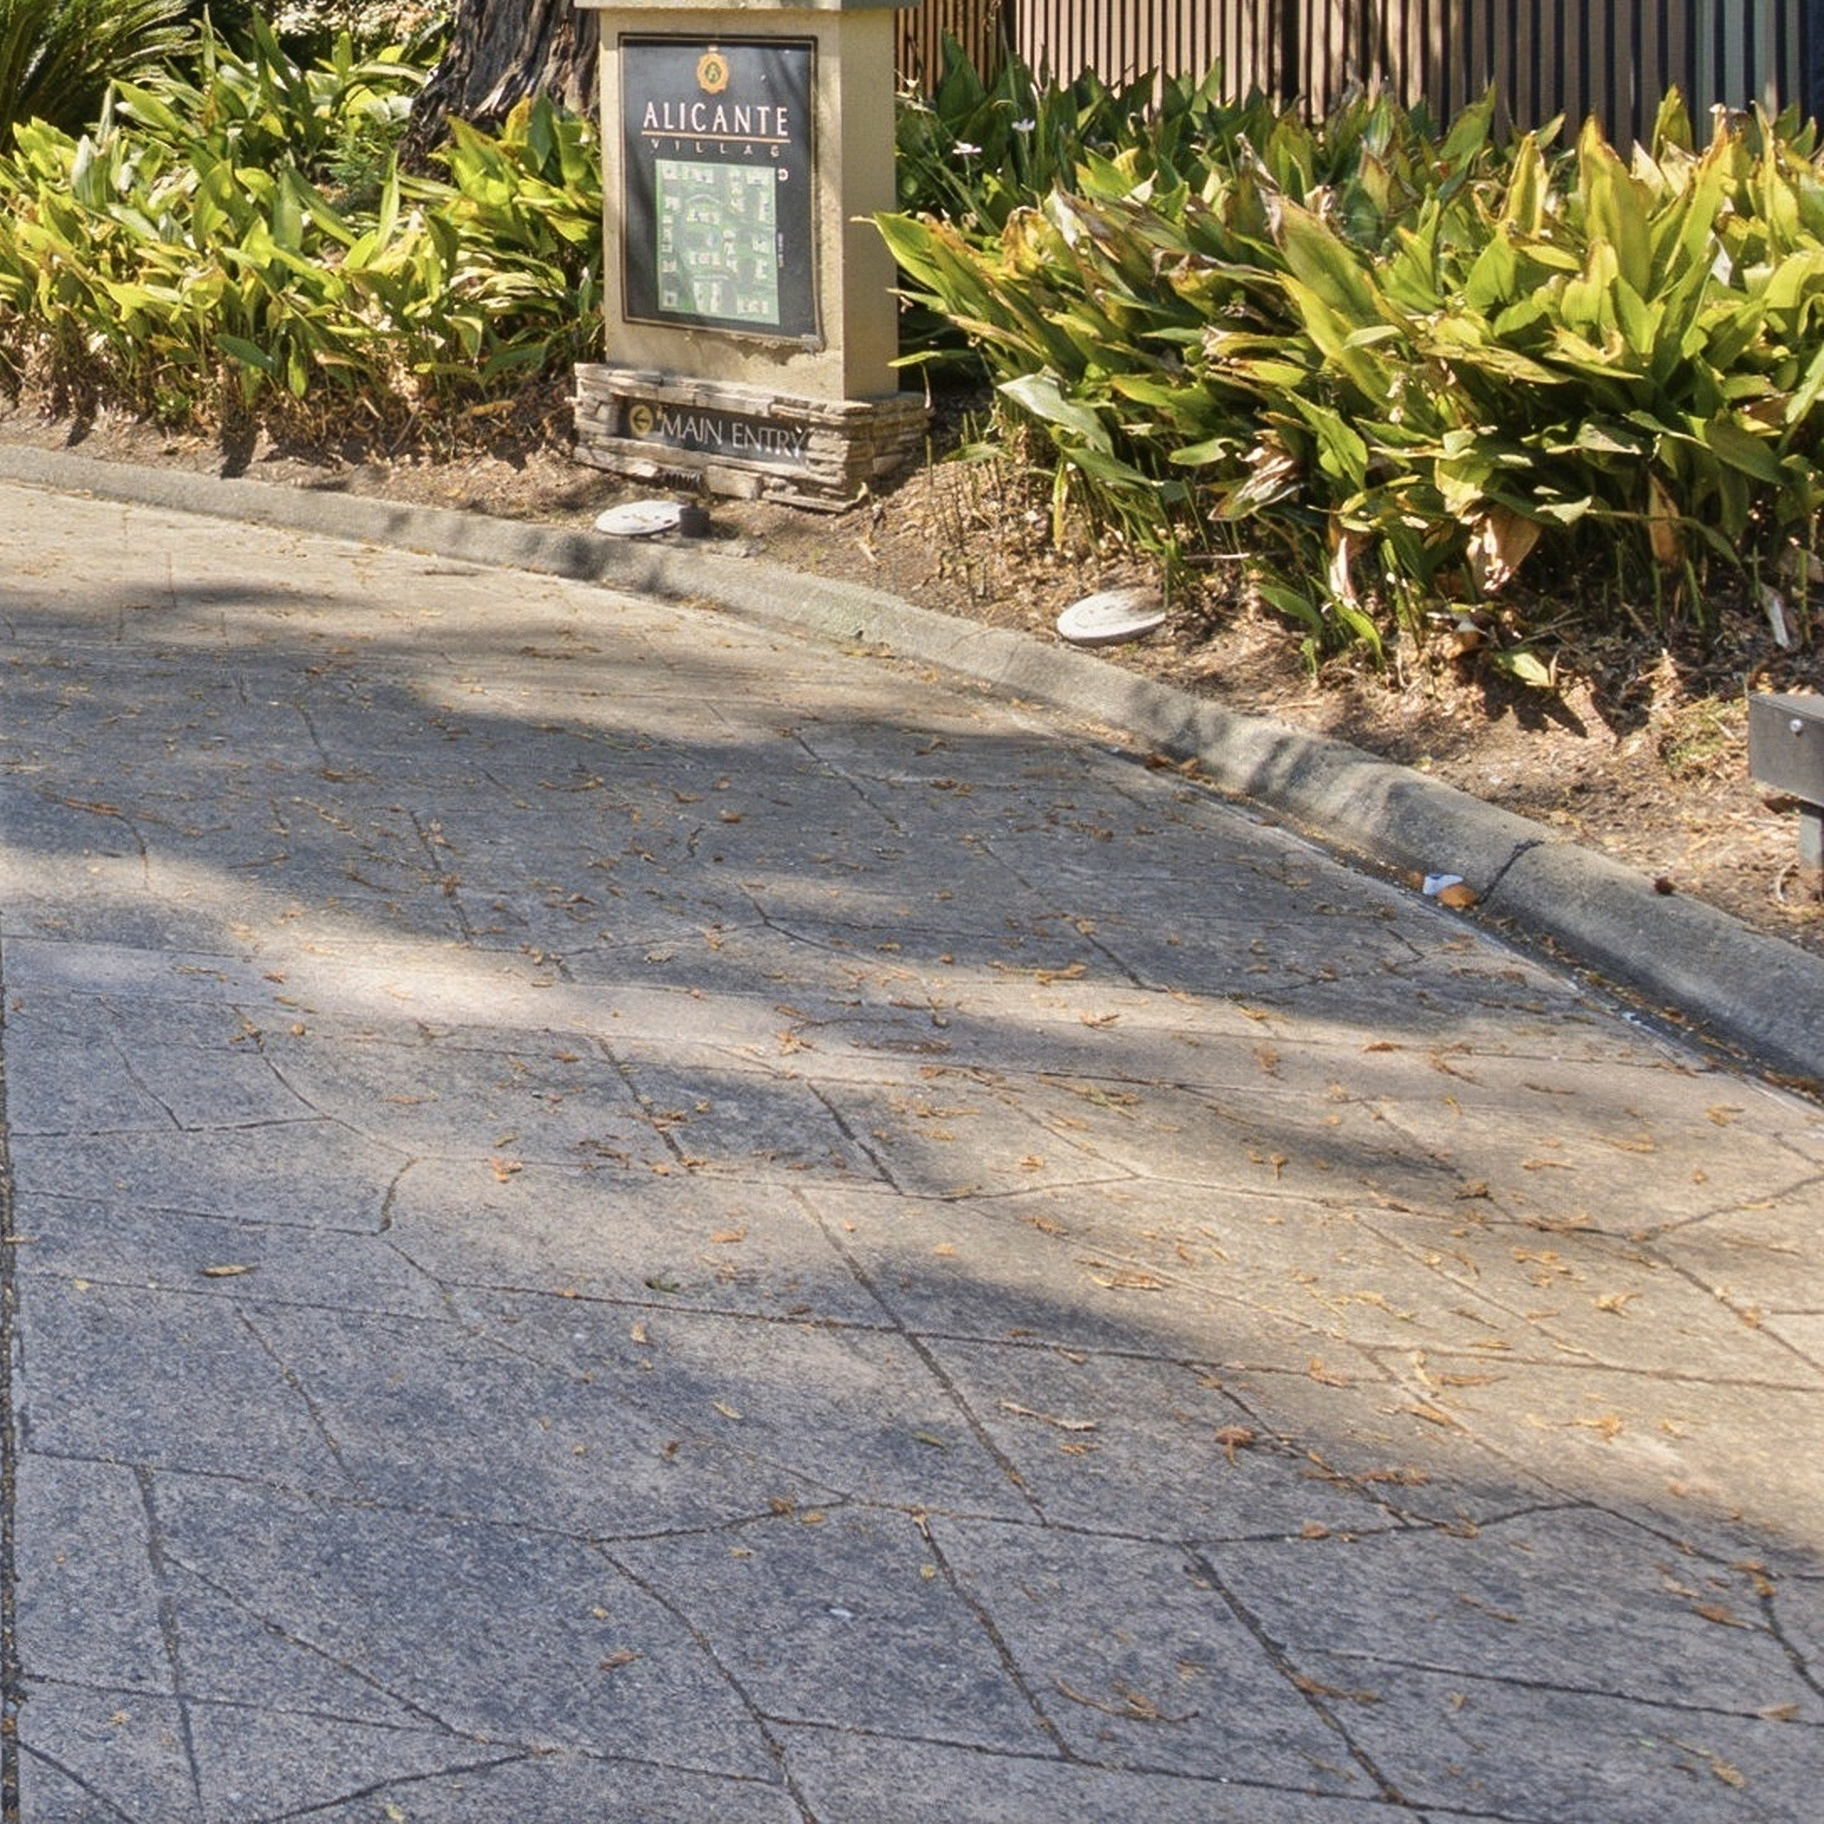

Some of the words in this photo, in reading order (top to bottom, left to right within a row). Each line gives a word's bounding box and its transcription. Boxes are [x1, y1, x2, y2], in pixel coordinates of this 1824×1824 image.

[643, 101, 789, 136] ALICANTE
[650, 138, 780, 158] VILLAS
[660, 413, 722, 445] MAIN
[732, 421, 810, 458] ENTRY
